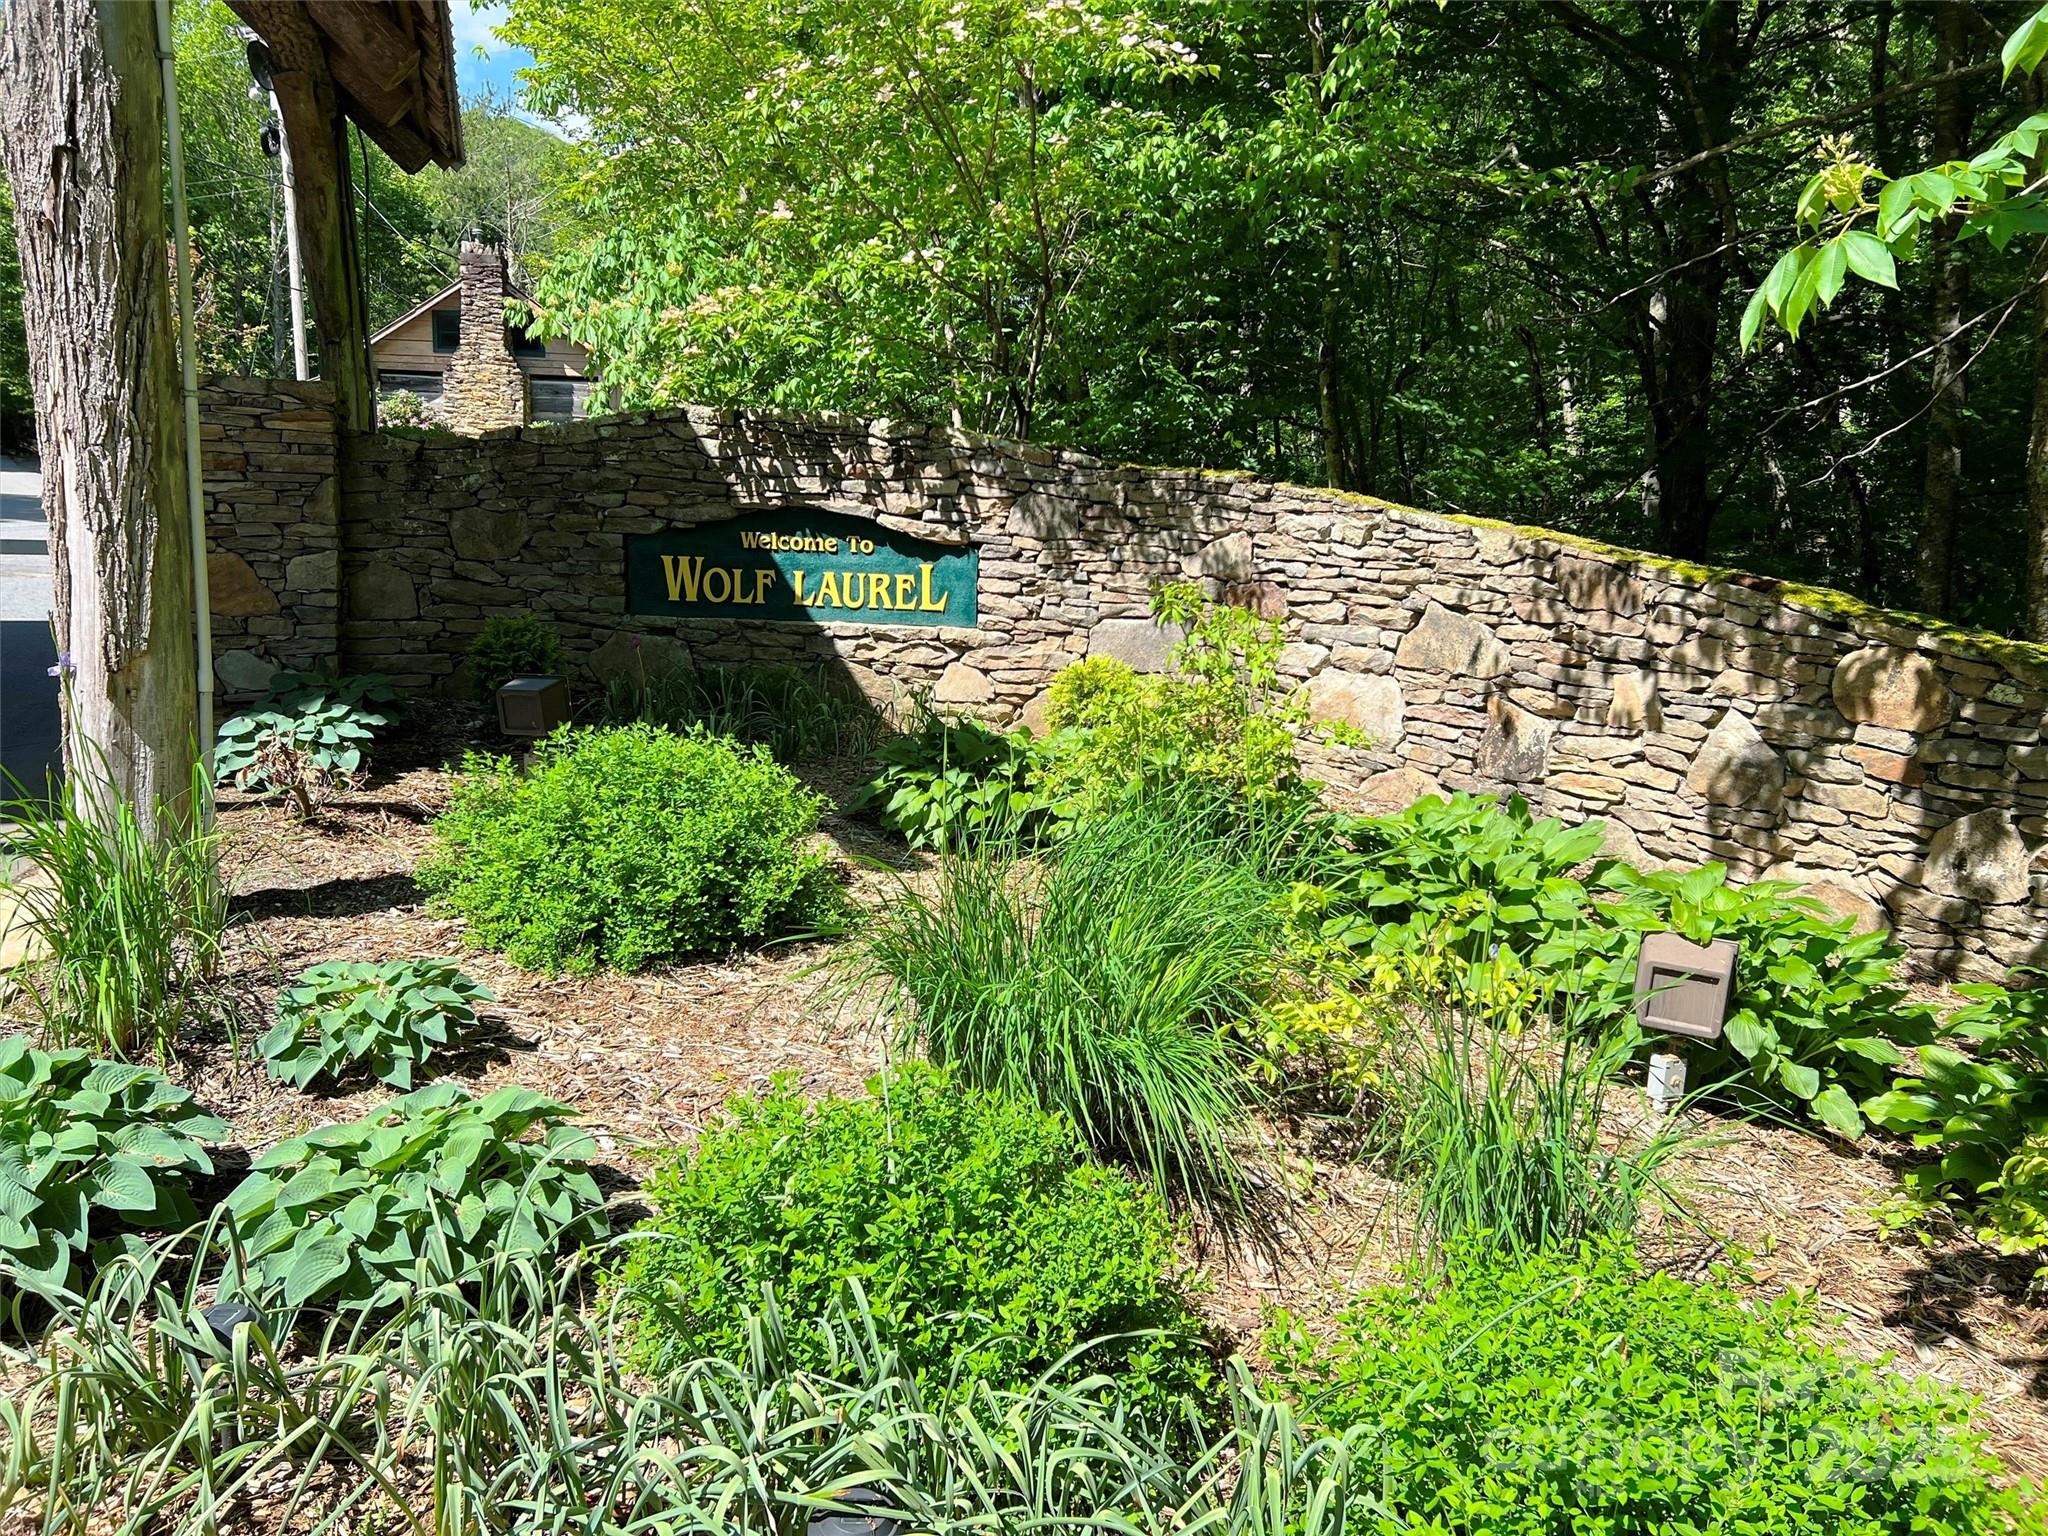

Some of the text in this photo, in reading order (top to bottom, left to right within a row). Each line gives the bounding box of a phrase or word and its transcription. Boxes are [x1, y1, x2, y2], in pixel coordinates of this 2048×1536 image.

[740, 531, 874, 554] Welcome To
[660, 555, 949, 613] WOLF LAUREL
